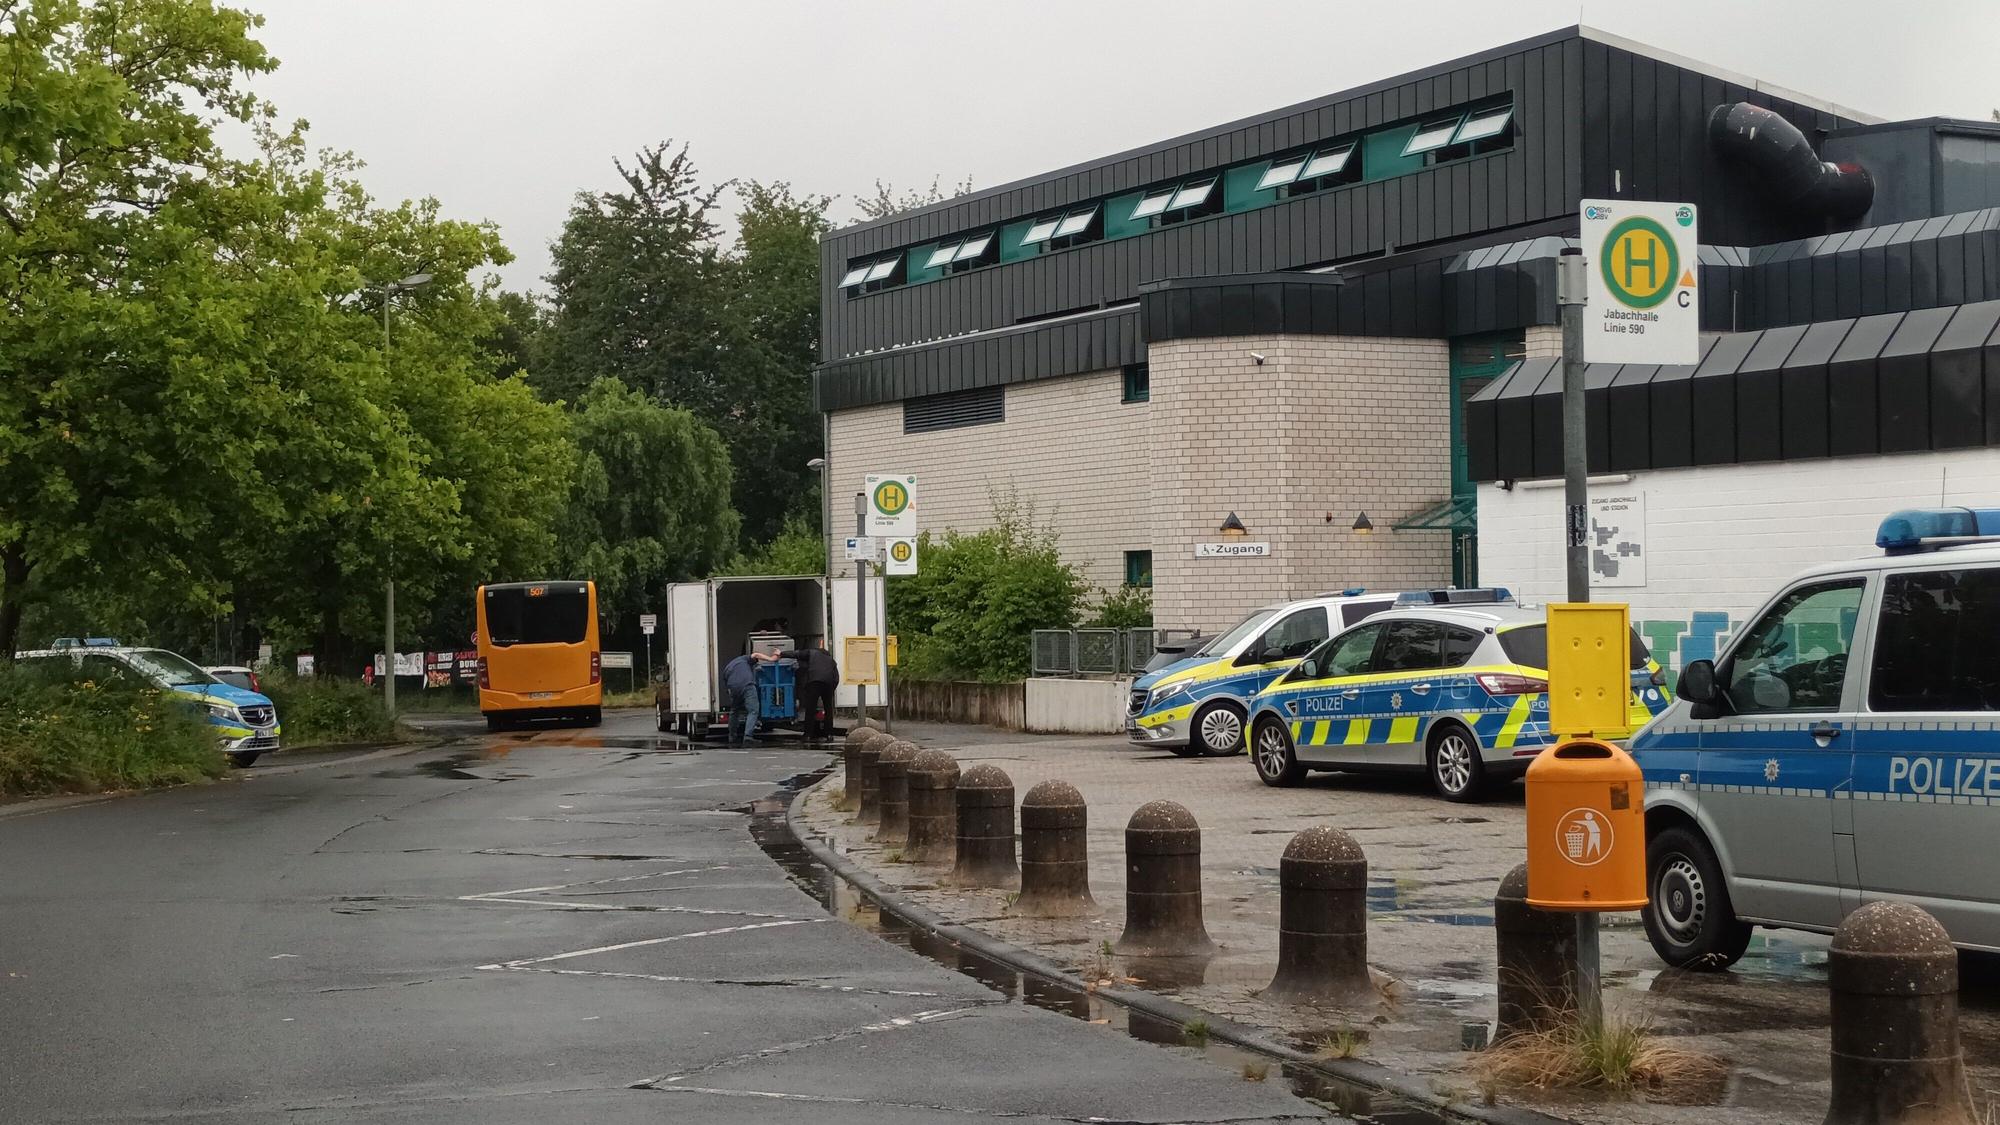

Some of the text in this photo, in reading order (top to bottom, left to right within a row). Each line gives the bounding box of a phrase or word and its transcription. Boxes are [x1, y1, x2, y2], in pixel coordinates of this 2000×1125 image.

[1624, 237, 1656, 289] H
[1677, 290, 1690, 308] C
[1603, 308, 1659, 322] Jabachhalle
[1603, 322, 1645, 335] Linie 590
[884, 487, 898, 508] H
[896, 546, 906, 557] H
[530, 587, 545, 596] 507
[1306, 696, 1344, 713] POLIZEI
[1888, 756, 2000, 797] POLIZE
